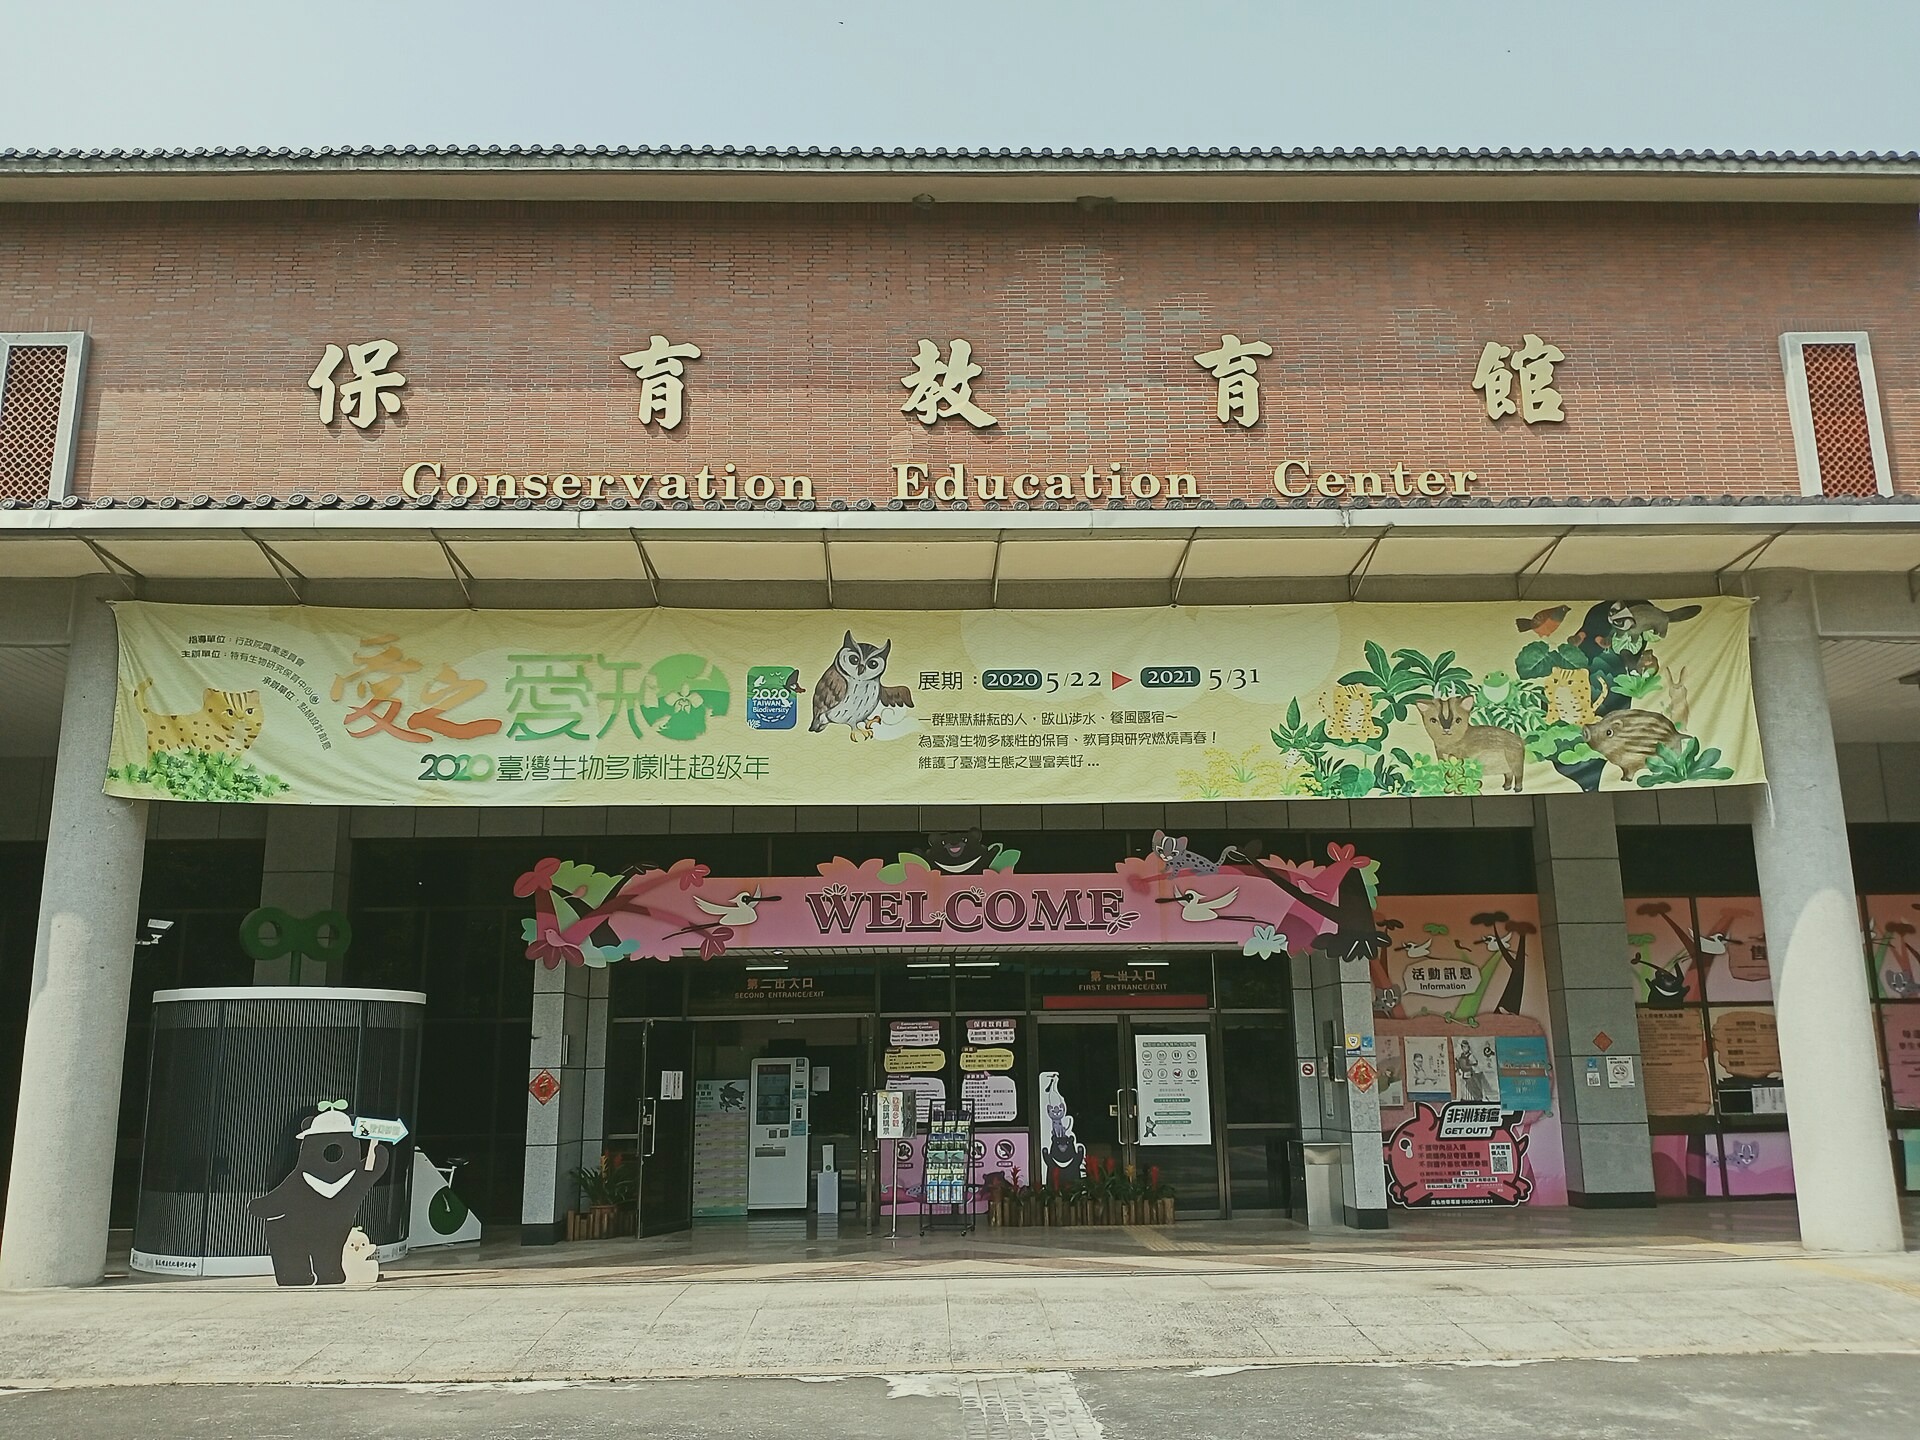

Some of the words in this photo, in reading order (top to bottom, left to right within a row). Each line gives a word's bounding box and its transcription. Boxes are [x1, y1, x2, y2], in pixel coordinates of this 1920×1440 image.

[307, 335, 1567, 429] 保育教育館
[401, 461, 817, 500] Conservation
[891, 462, 1201, 500] Education
[1273, 459, 1478, 499] Center
[986, 672, 1039, 687] 2020
[1147, 670, 1194, 684] 2021
[752, 688, 790, 700] 2020
[752, 706, 790, 714] Biodiversity
[805, 888, 1126, 934] WELCOME
[1411, 966, 1473, 981] 活動訊息
[1105, 983, 1168, 991] ENTRANCE/EXIT
[1419, 982, 1467, 990] Information
[734, 991, 765, 999] SECOND
[767, 990, 825, 999] ENTRANCE/EXIT
[1446, 1107, 1501, 1123] 非洲豬瘟
[1444, 1127, 1465, 1135] GET
[1465, 1126, 1489, 1135] OUT!
